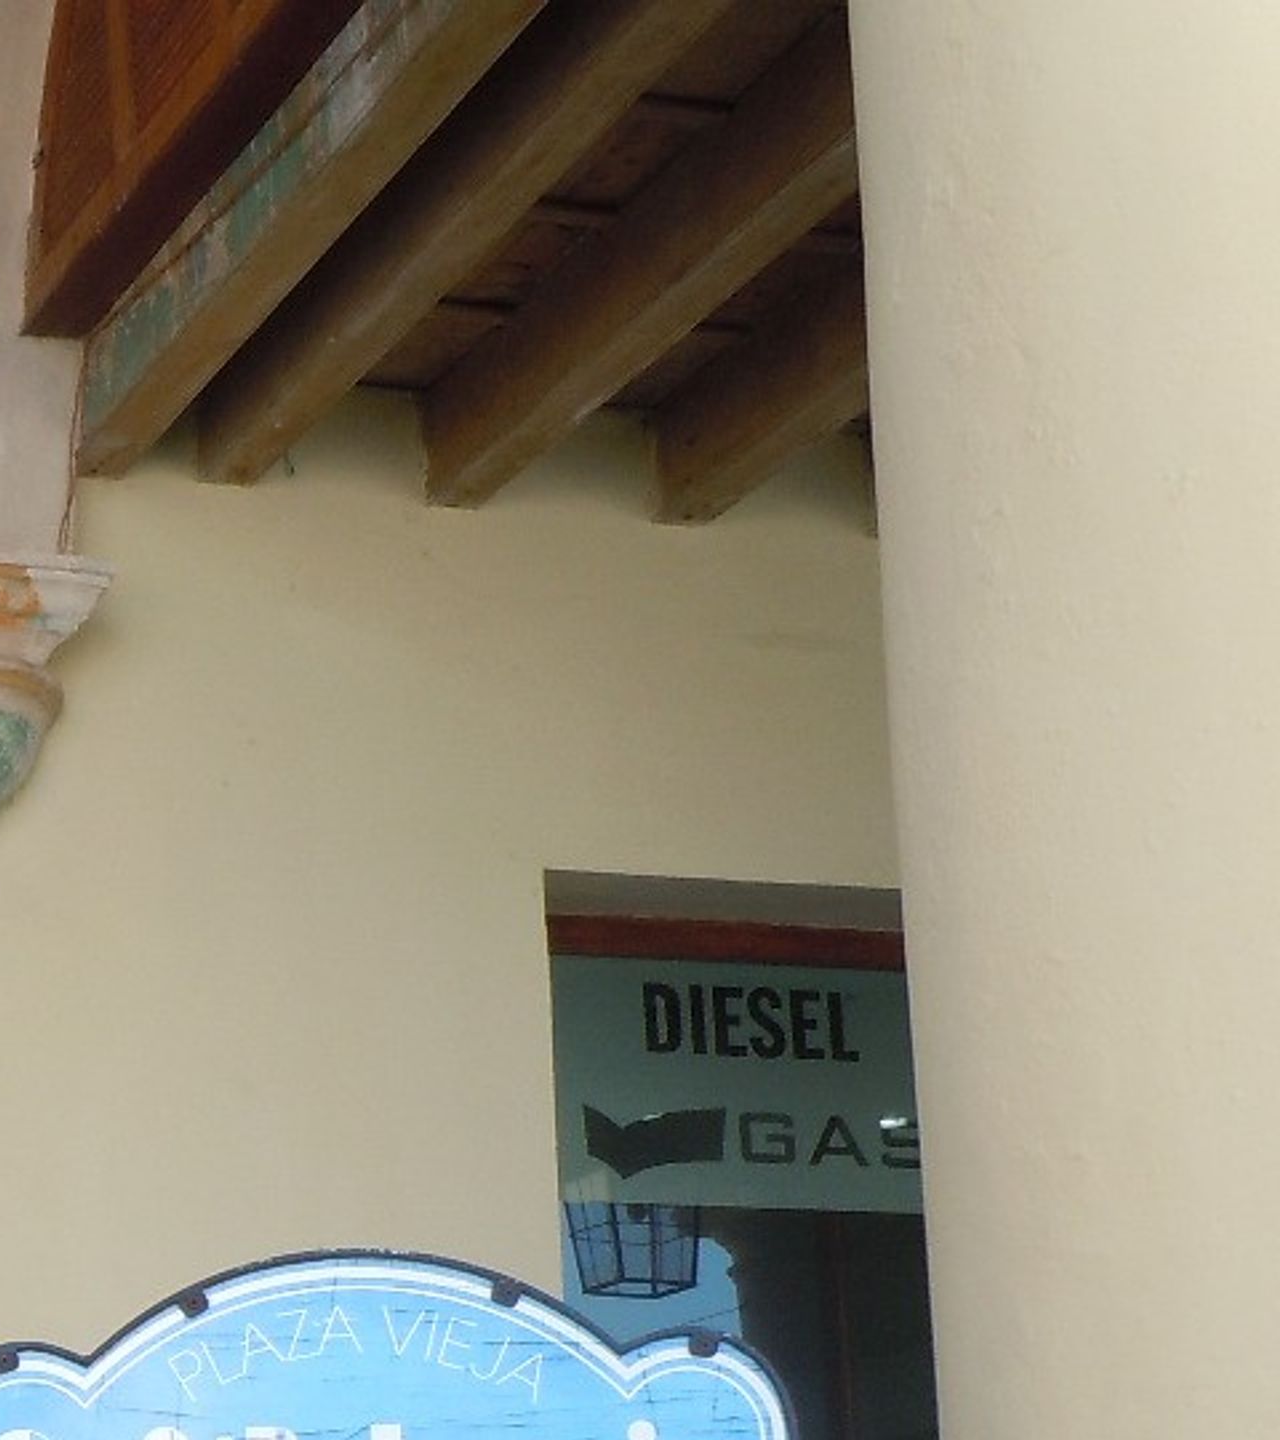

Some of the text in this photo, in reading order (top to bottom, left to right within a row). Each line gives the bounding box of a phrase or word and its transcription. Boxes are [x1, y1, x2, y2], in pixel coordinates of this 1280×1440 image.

[642, 981, 860, 1062] DIESEL
[167, 1304, 544, 1404] PLAZA VIEJA
